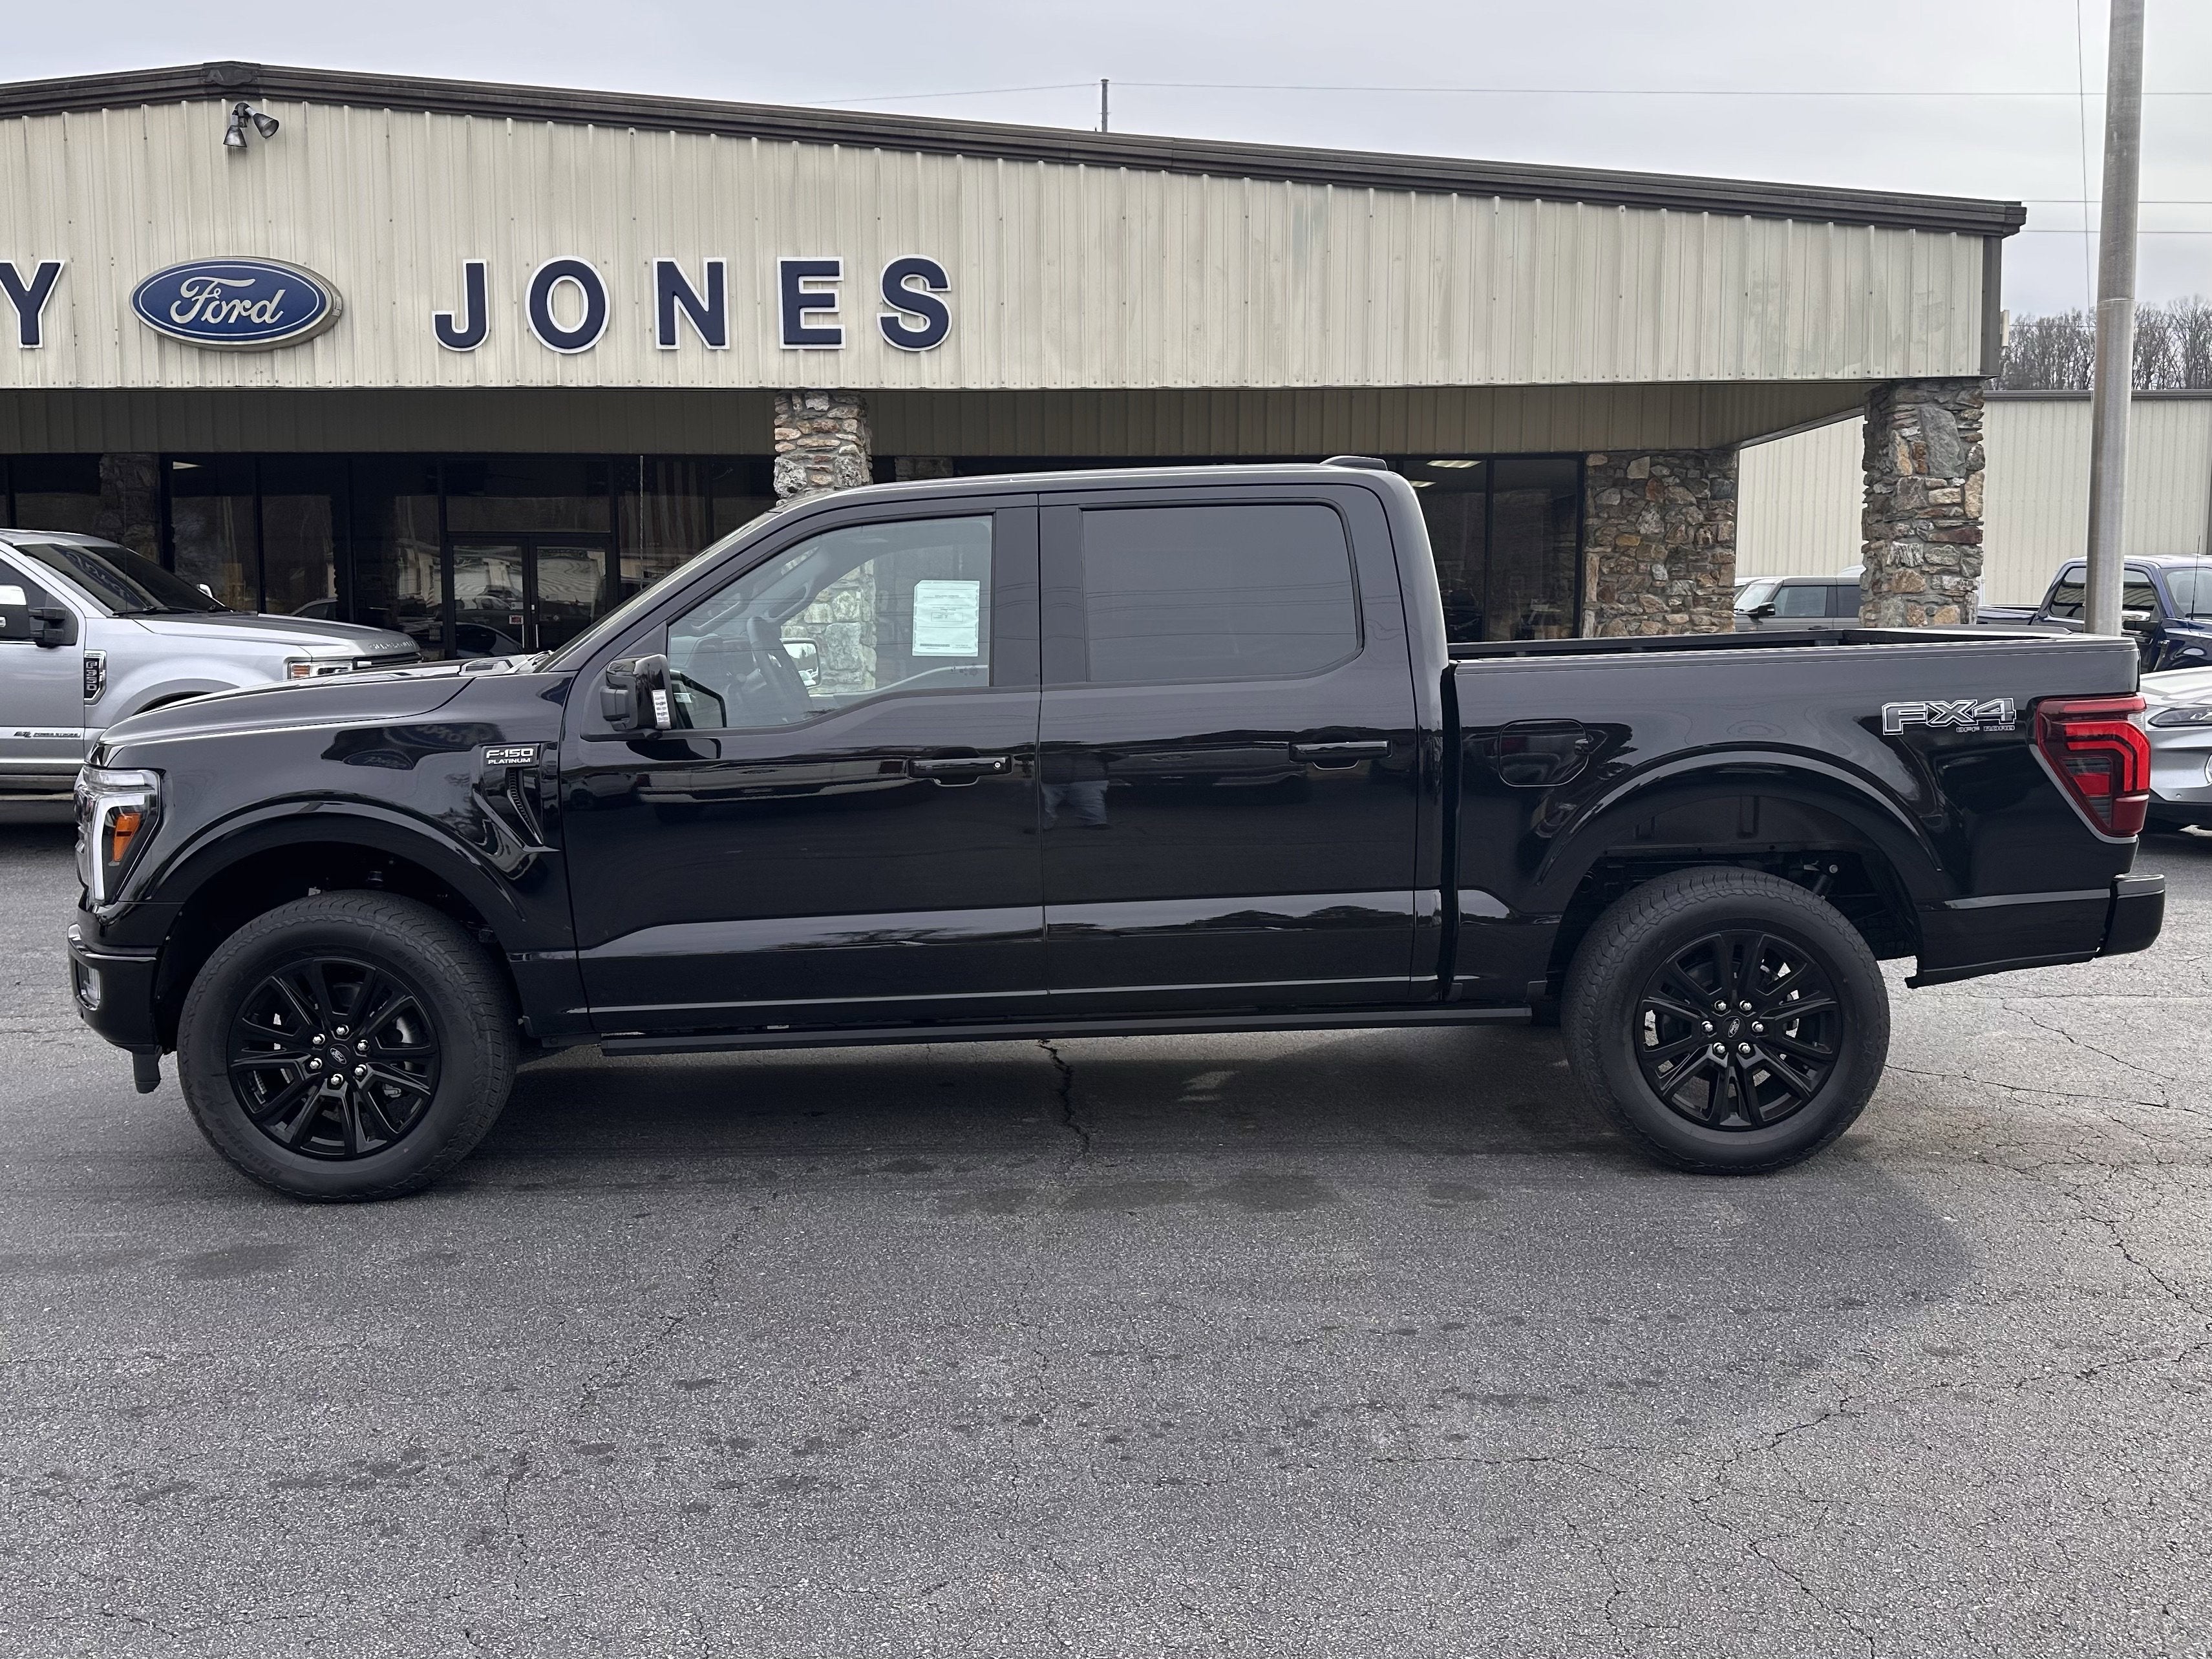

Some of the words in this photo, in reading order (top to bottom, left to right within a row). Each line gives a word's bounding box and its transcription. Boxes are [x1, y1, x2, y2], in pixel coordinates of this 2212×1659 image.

[0, 260, 65, 348] Y
[169, 276, 286, 324] Ford
[432, 254, 952, 354] JONES
[1882, 698, 2017, 735] FX4
[486, 748, 534, 759] F-150
